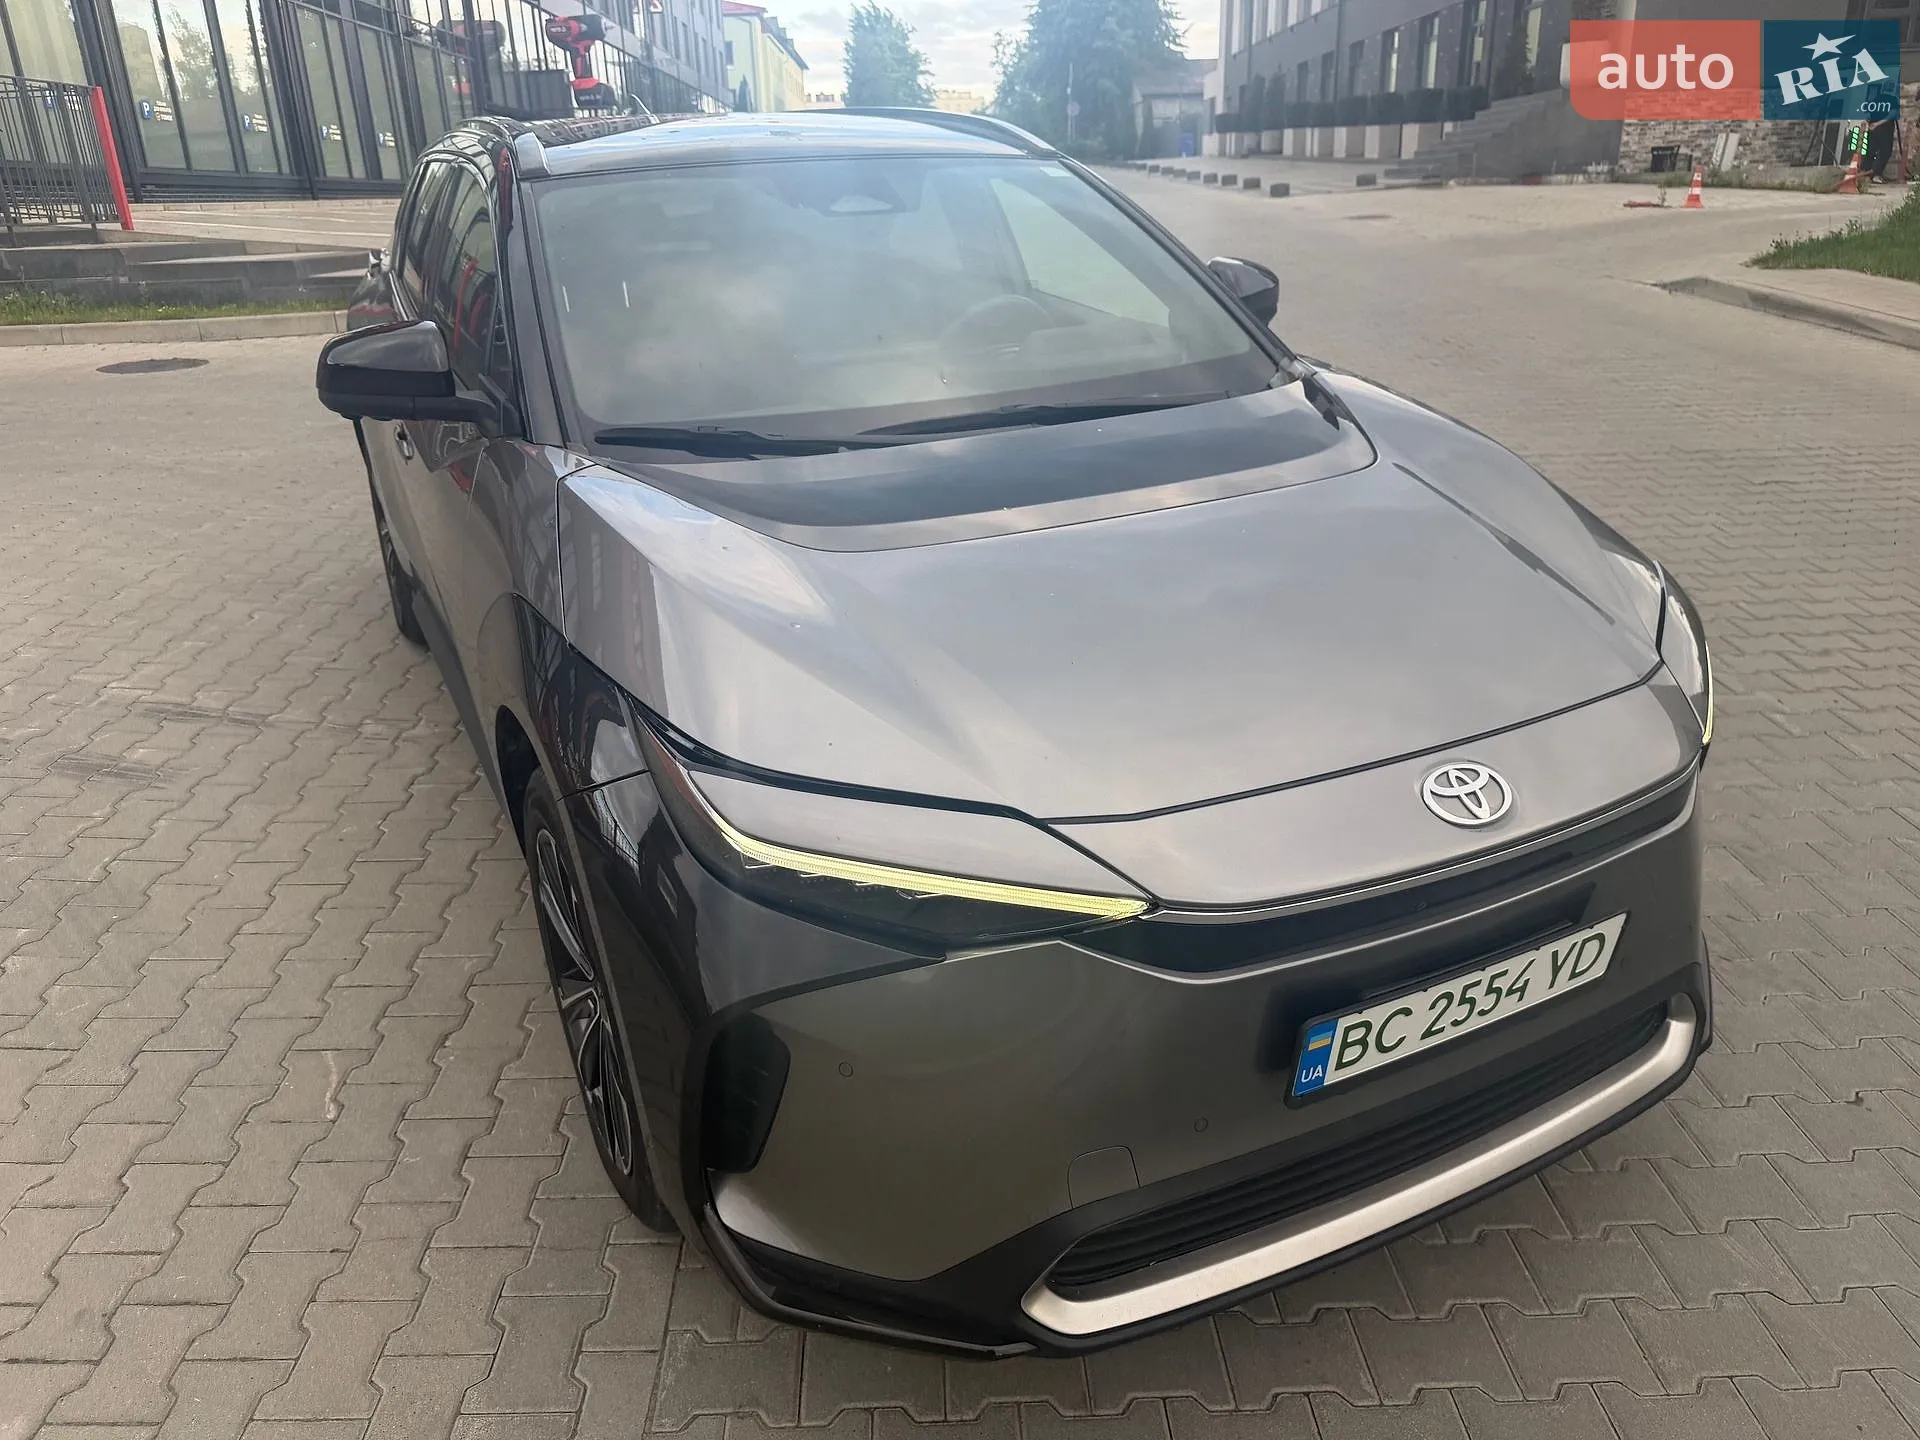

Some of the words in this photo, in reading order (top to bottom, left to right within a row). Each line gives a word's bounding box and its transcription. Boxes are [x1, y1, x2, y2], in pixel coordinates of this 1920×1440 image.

[1334, 1007, 1413, 1072] BC
[1420, 958, 1535, 1041] 2554
[1548, 932, 1606, 990] YD
[1301, 1064, 1323, 1084] UA
